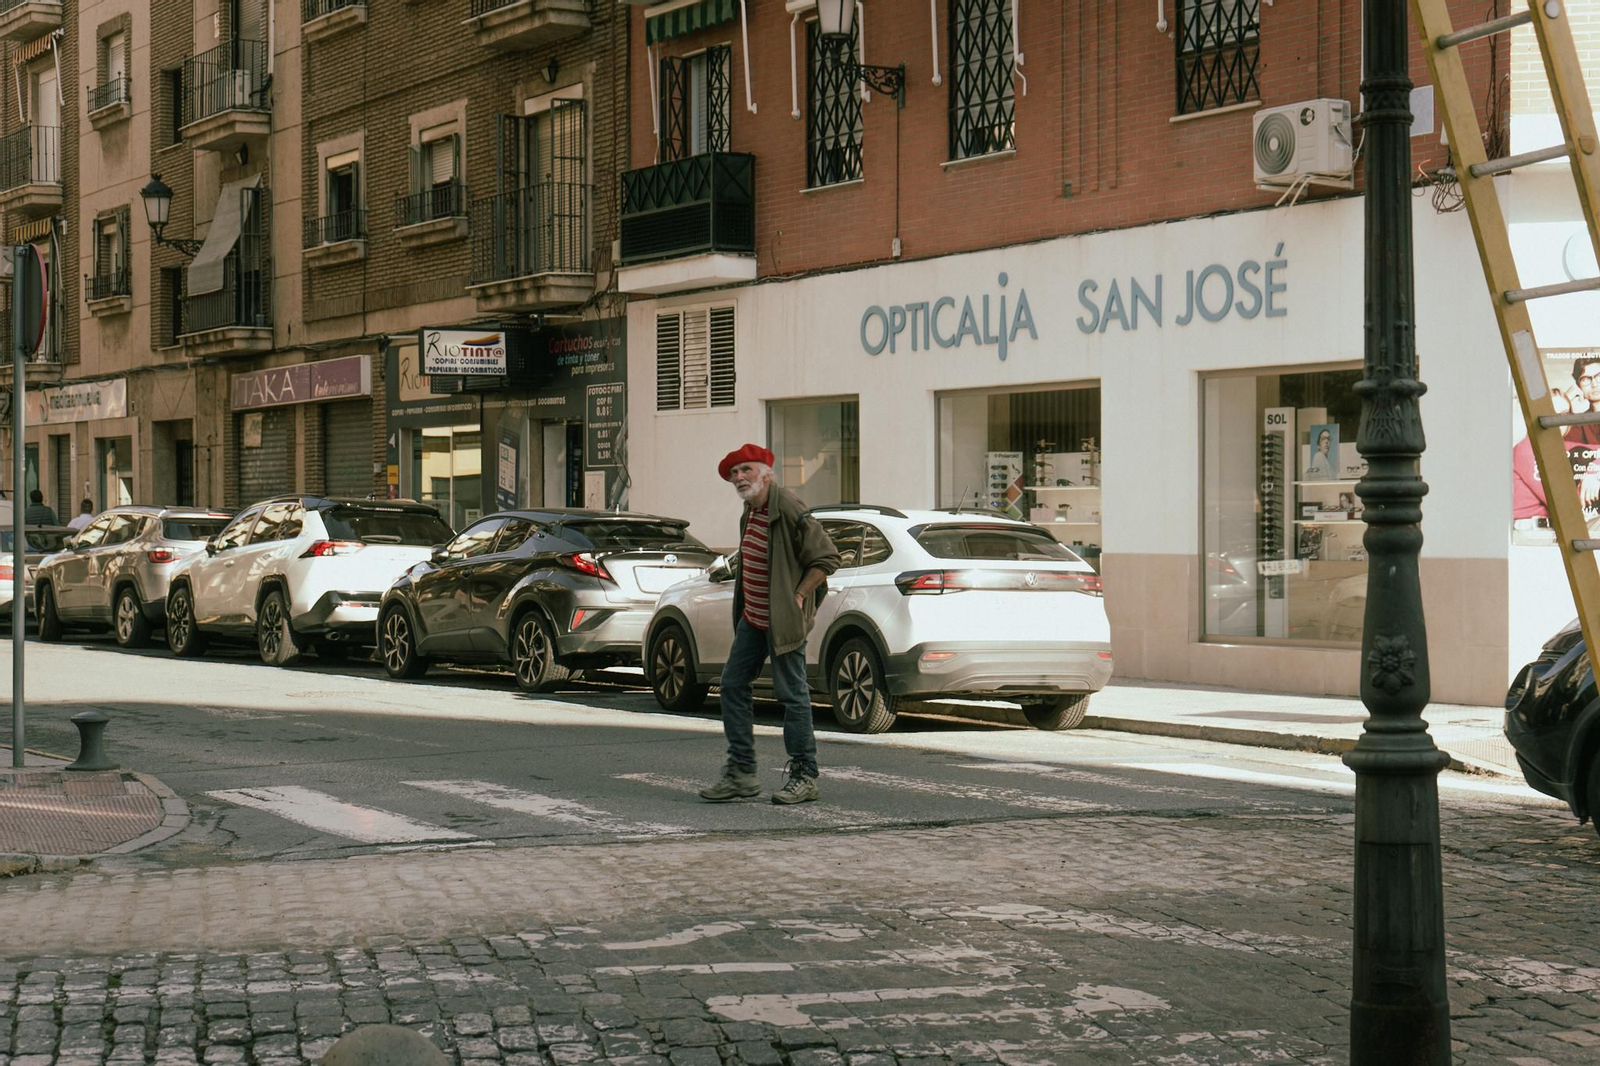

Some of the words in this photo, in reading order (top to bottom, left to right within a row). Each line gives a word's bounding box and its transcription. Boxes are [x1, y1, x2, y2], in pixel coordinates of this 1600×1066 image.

[1076, 274, 1163, 333] SAN
[1175, 242, 1288, 325] JOSÉ
[1267, 414, 1287, 425] SOL
